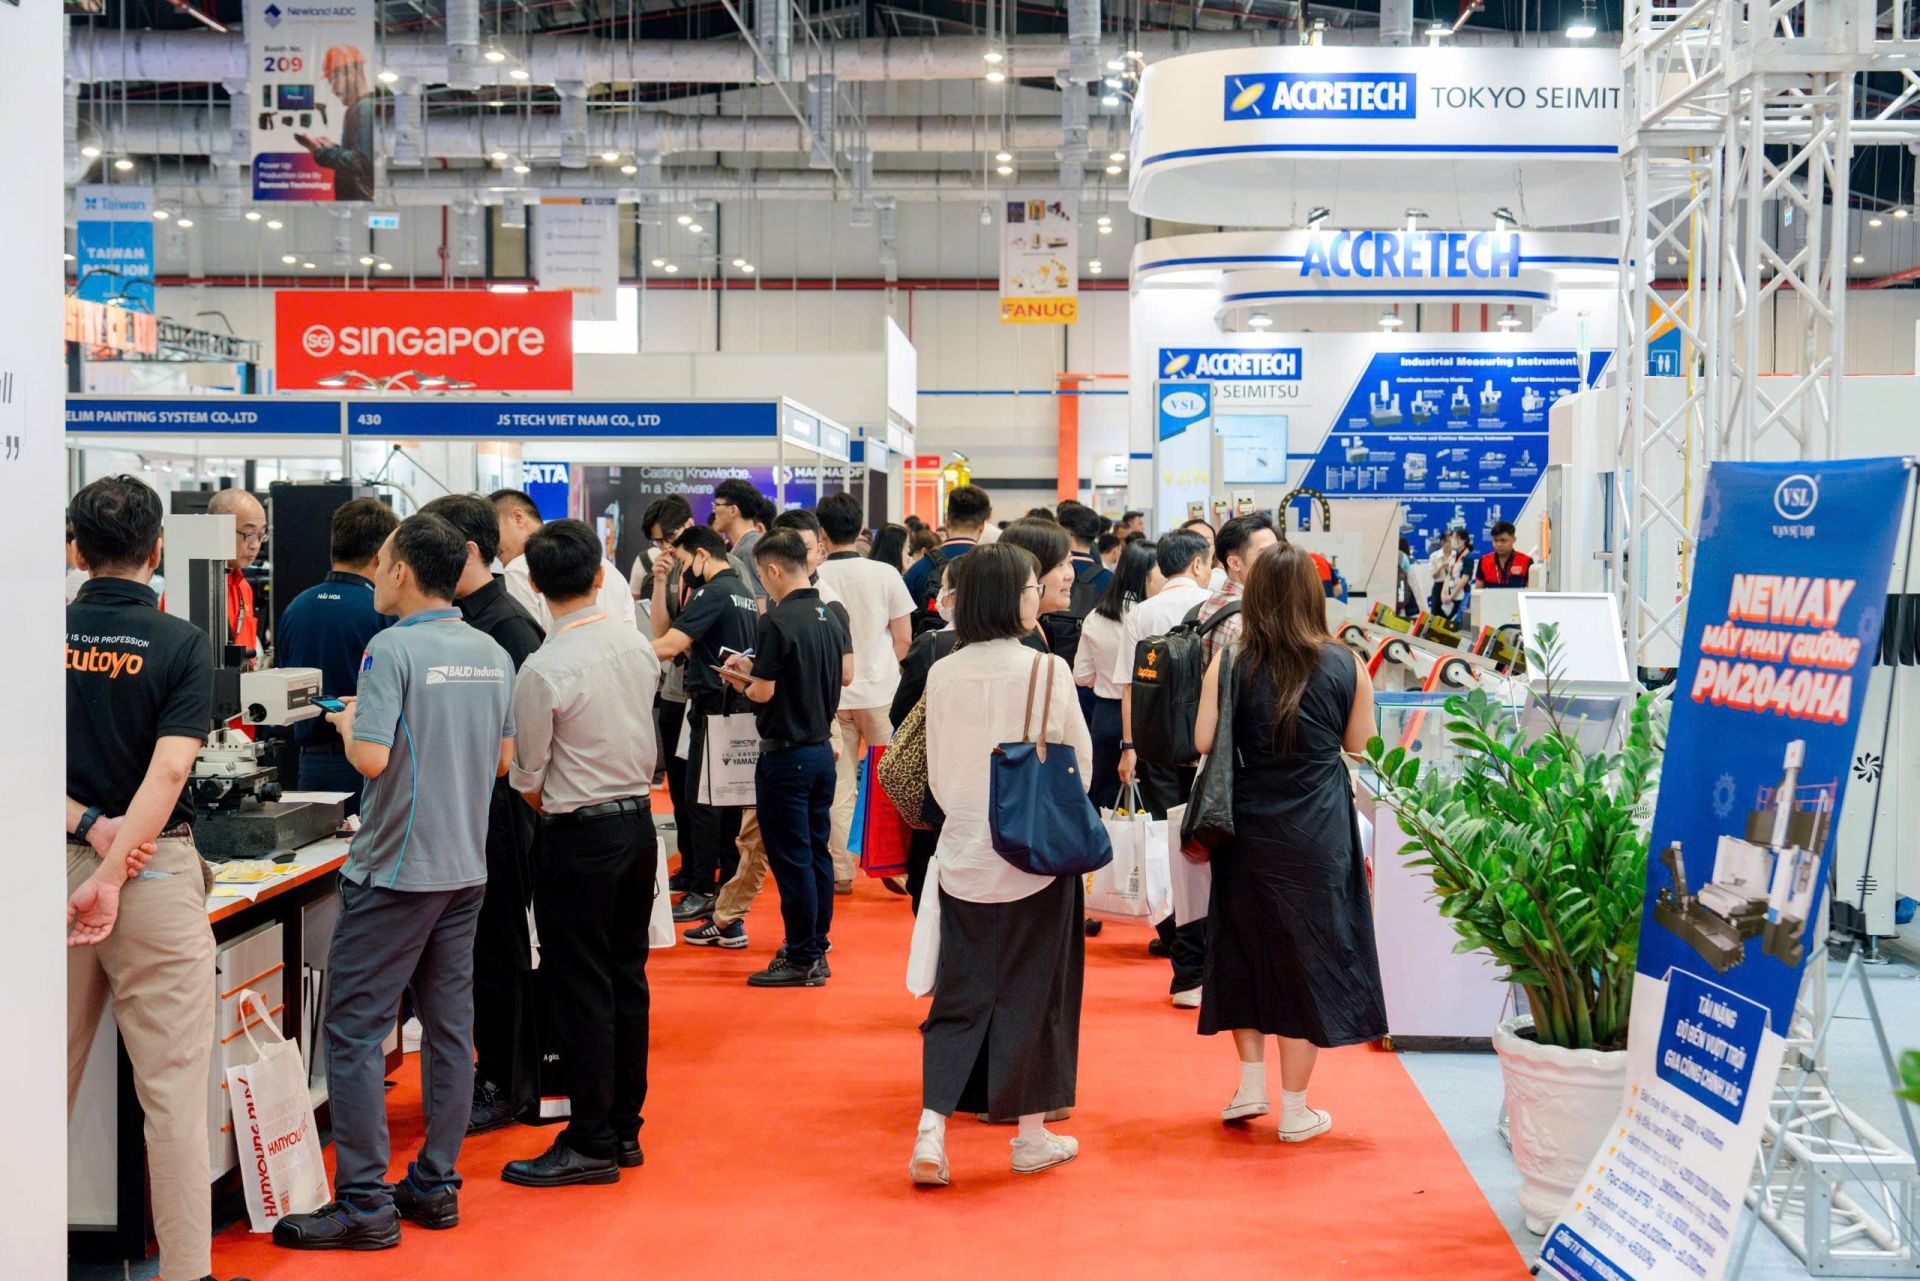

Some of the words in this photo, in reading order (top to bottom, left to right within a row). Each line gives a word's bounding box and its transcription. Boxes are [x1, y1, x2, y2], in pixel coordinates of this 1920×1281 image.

[287, 7, 331, 16] Newland
[264, 57, 303, 72] 209
[1271, 81, 1407, 111] ACCRETECH
[1431, 87, 1525, 109] TOKYO
[102, 199, 146, 210] Taiwan
[86, 247, 145, 259] TAIWAN
[1300, 231, 1520, 278] ACCRETECH
[1002, 303, 1074, 317] FANUC
[1195, 353, 1297, 376] ACCRETECH
[1400, 356, 1453, 366] Industrial
[1456, 356, 1514, 368] Measuring
[1223, 385, 1299, 398] SEIMITSU
[1170, 400, 1198, 410] VSL
[96, 411, 156, 423] PAINTING
[159, 412, 208, 423] SYSTEM
[357, 414, 382, 425] 430
[496, 414, 511, 426] JS
[512, 414, 545, 425] TECH
[546, 414, 575, 425] VIET
[577, 414, 608, 425] NAM
[637, 414, 661, 425] LTD
[641, 467, 684, 480] Casting
[653, 484, 662, 494] a
[1783, 488, 1809, 506] VSL
[1729, 573, 1856, 628] NEWAY
[71, 633, 80, 641] IS
[81, 634, 100, 644] OUR
[101, 635, 149, 648] PROFESSION
[1700, 620, 1742, 657] MÁY
[1740, 629, 1792, 663] PHAY
[449, 665, 472, 677] BAUD
[1691, 658, 1853, 725] PM2040HA
